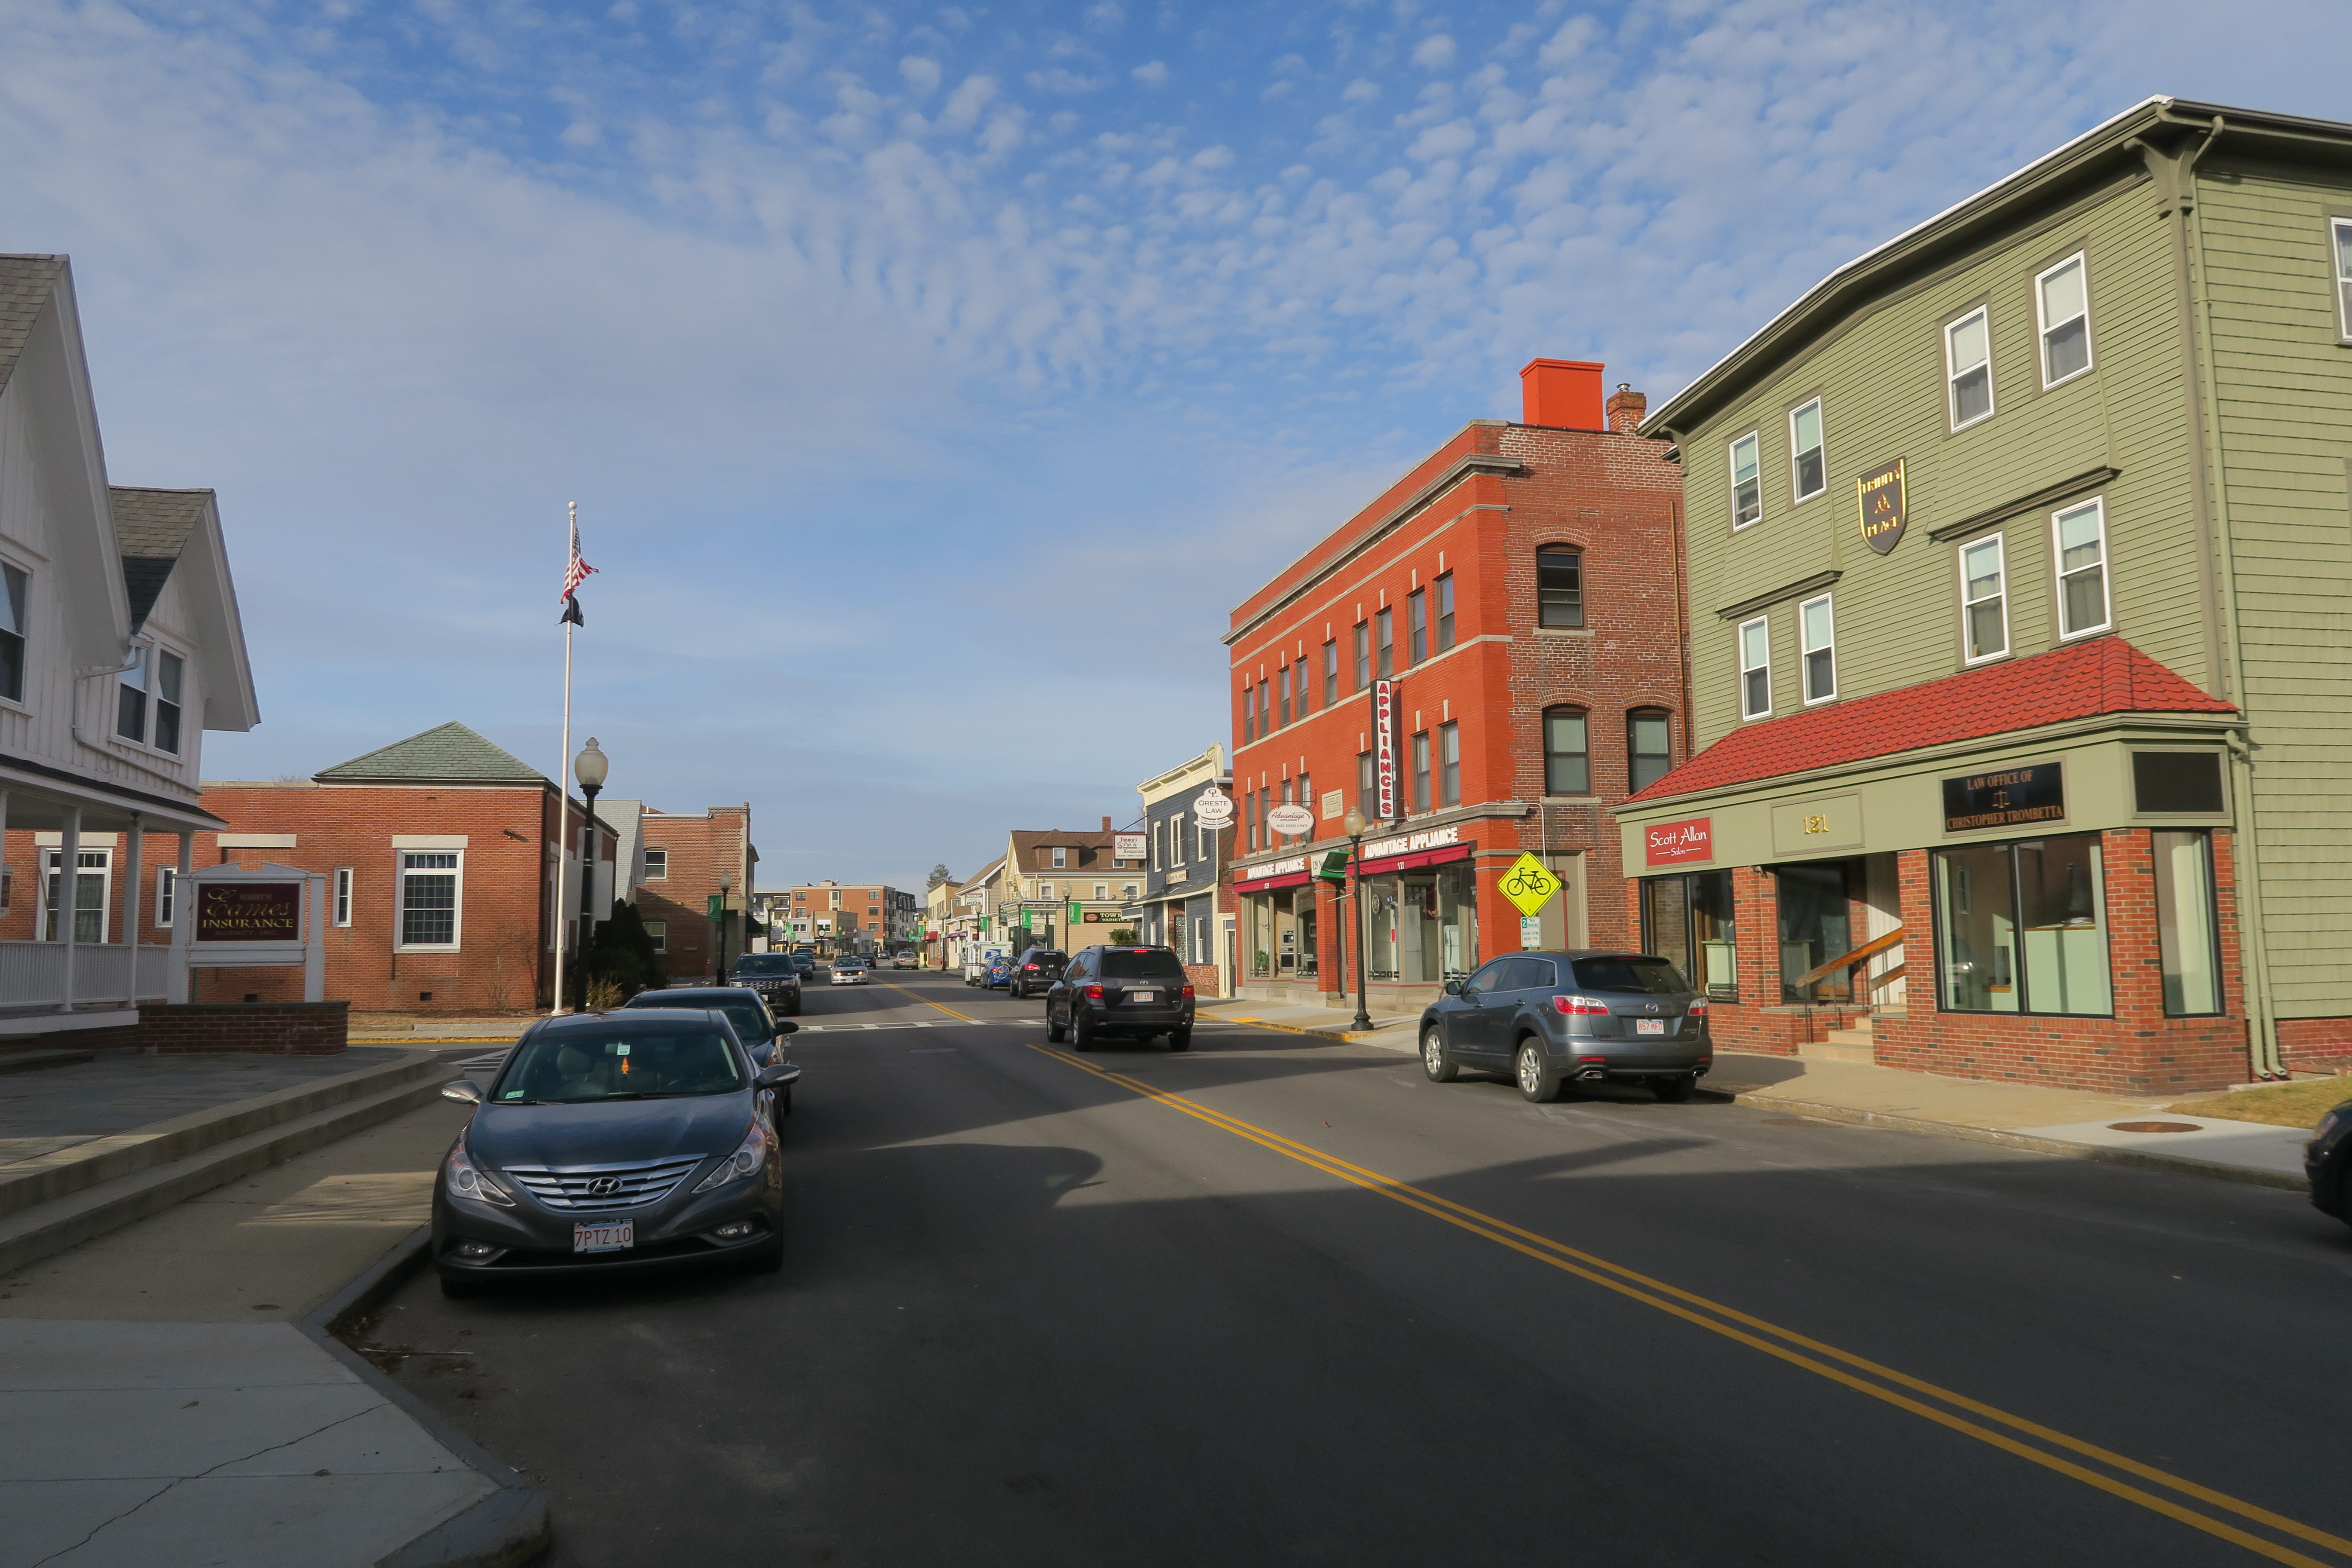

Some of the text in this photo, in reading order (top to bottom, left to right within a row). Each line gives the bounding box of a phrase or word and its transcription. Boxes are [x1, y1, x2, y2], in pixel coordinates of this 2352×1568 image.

[1861, 468, 1900, 494] TRINITY
[1379, 683, 1392, 815] APPLIANCES
[1967, 770, 2033, 790] LAW OFFICE OF
[1271, 811, 1305, 821] Advantage
[1804, 814, 1828, 834] 121
[1946, 805, 2063, 829] CHRISTOPHER TROMBETTA
[1364, 827, 1458, 859] ADVANTAGE APPLIANCE
[1650, 826, 1707, 847] Scott Allan
[1671, 847, 1685, 856] Salon
[1247, 864, 1275, 880] ADVANTAGE
[1275, 858, 1305, 875] APPLIANCE
[206, 888, 291, 917] Eames
[202, 919, 293, 928] INSURANCE
[575, 1227, 631, 1246] 7PTZ 10
